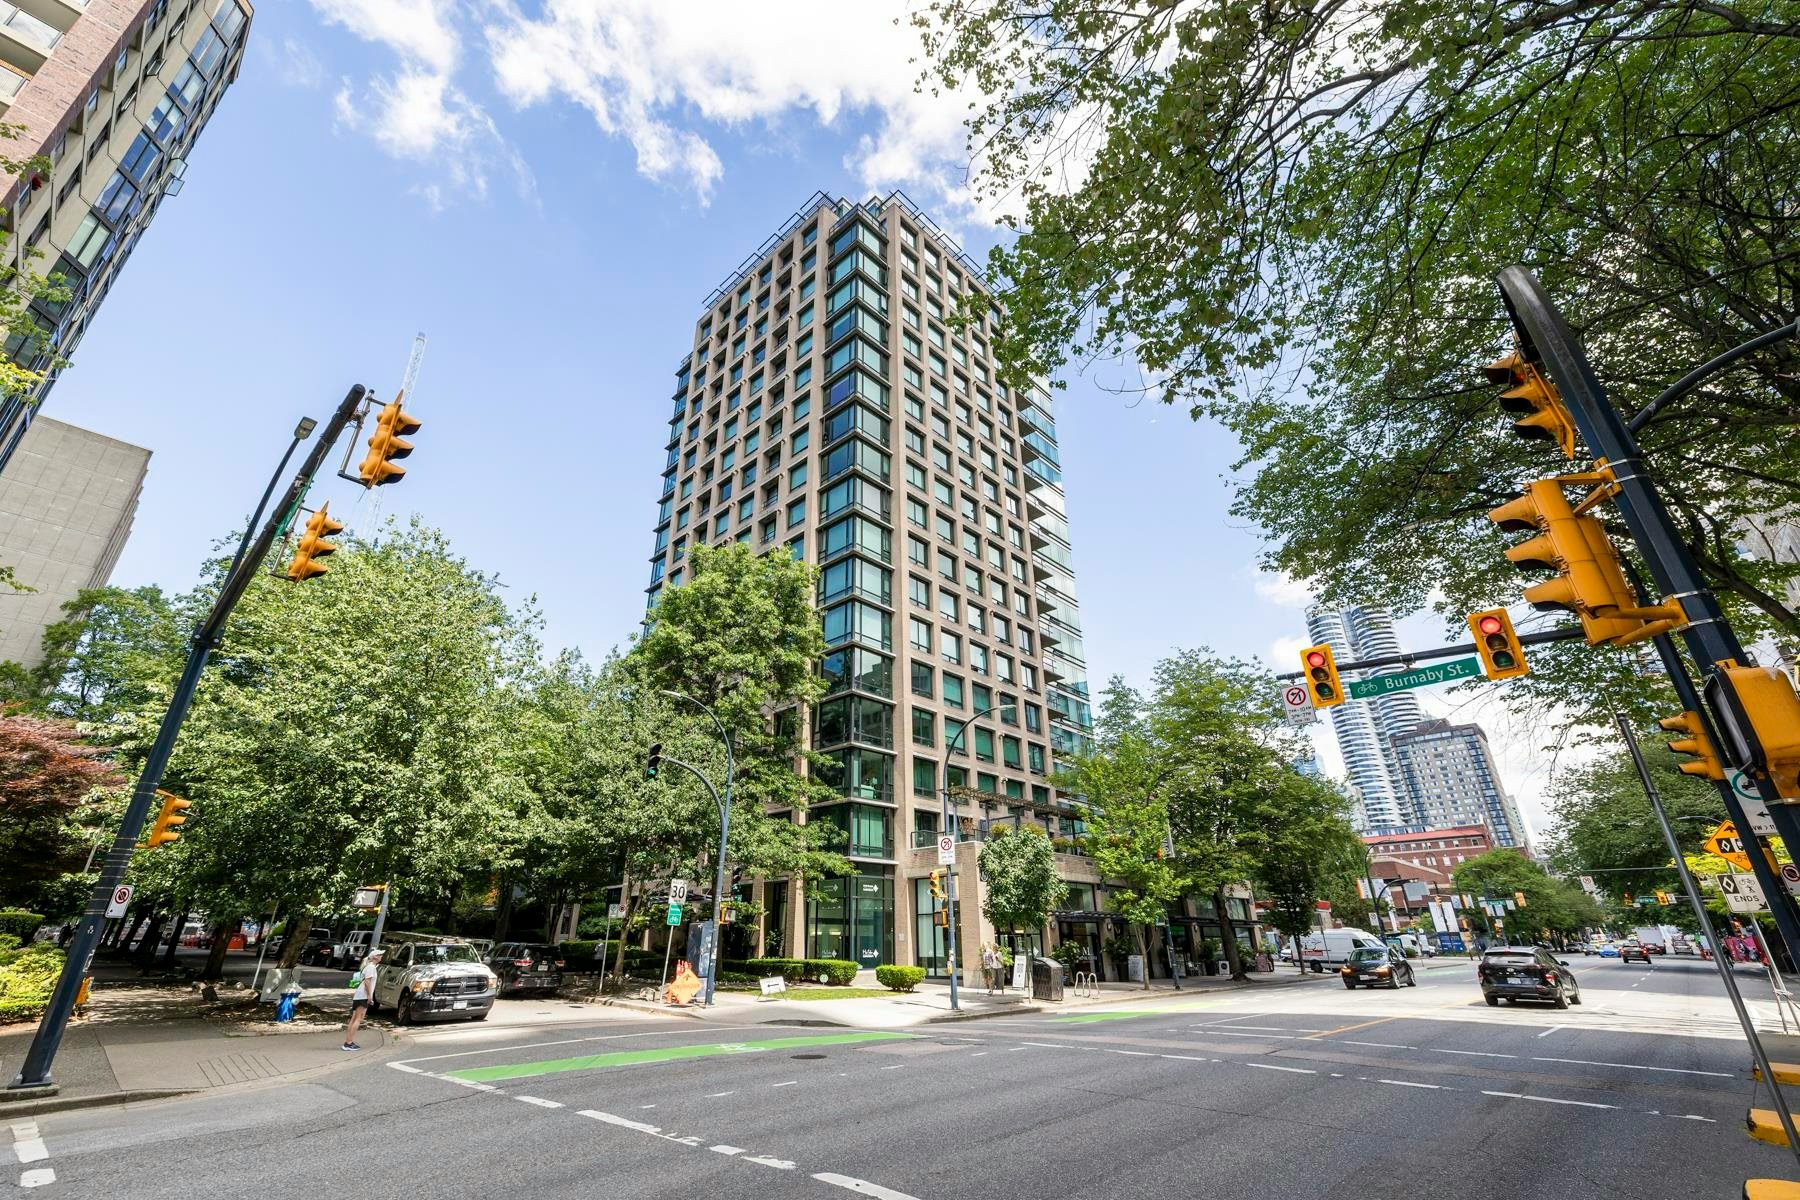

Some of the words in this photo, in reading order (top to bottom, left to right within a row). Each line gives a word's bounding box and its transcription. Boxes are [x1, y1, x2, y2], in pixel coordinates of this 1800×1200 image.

[1385, 670, 1444, 689] Burnaby
[1447, 664, 1470, 677] St.
[672, 886, 685, 898] 30
[1733, 894, 1760, 903] ENDS
